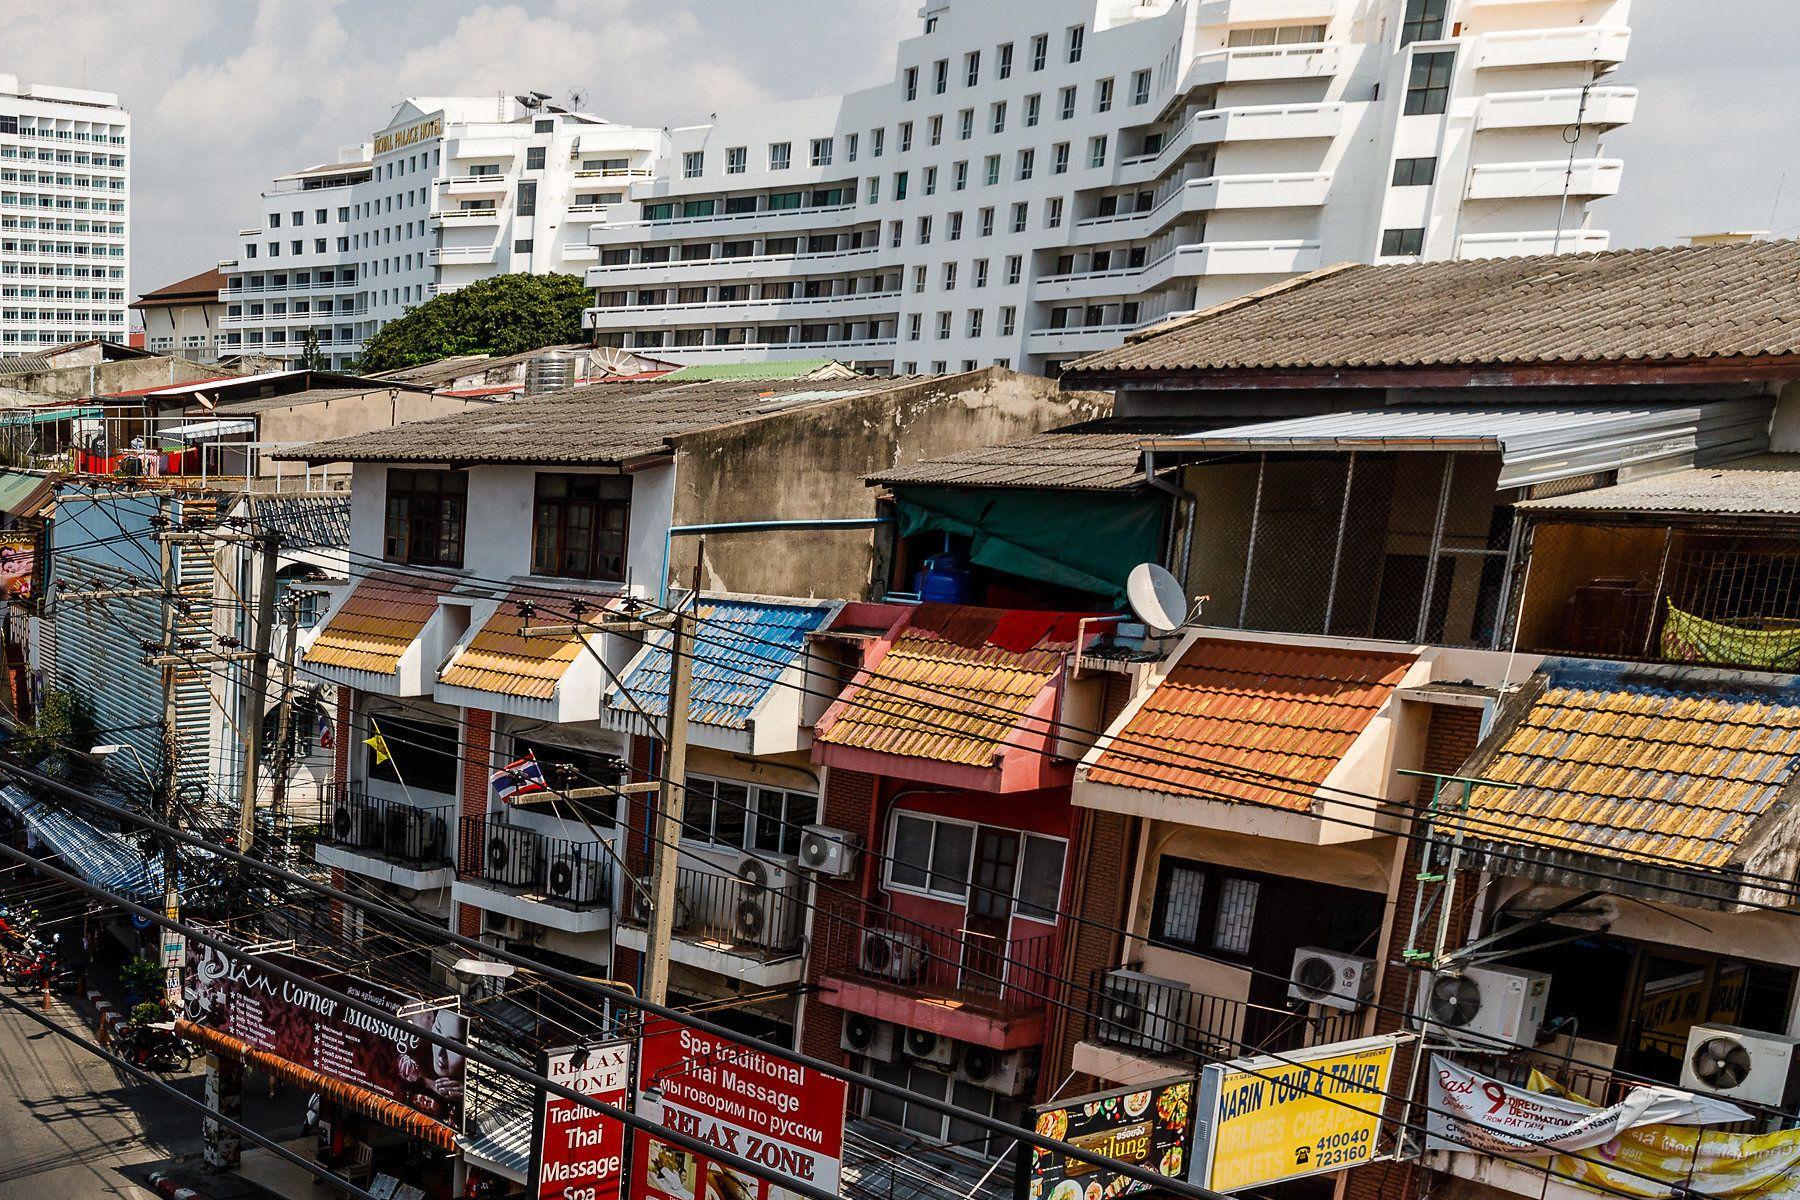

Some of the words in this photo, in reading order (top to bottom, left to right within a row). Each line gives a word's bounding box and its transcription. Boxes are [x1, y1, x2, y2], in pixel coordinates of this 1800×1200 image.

[283, 980, 338, 1018] Corner
[343, 1006, 419, 1054] Massage
[679, 1028, 711, 1057] Spa
[715, 1040, 805, 1086] traditional
[681, 1055, 717, 1084] Thai
[722, 1071, 800, 1114] Massage
[1217, 1080, 1265, 1125] NARIN
[1269, 1067, 1311, 1107] TOUR
[1313, 1065, 1324, 1097] &
[1329, 1063, 1381, 1095] TRAVEL
[1481, 1081, 1507, 1115] 9
[550, 1096, 623, 1125] Traditioal
[684, 1086, 746, 1120] говорим
[748, 1106, 767, 1126] по
[770, 1115, 824, 1144] русски
[1481, 1114, 1503, 1124] FROM
[1508, 1097, 1544, 1113] DIRECT
[565, 1123, 603, 1149] Thai
[661, 1103, 740, 1156] RELAX
[746, 1134, 816, 1182] ZONE
[1316, 1128, 1370, 1151] 410040
[541, 1155, 620, 1184] Massage
[1315, 1144, 1367, 1168] 723160
